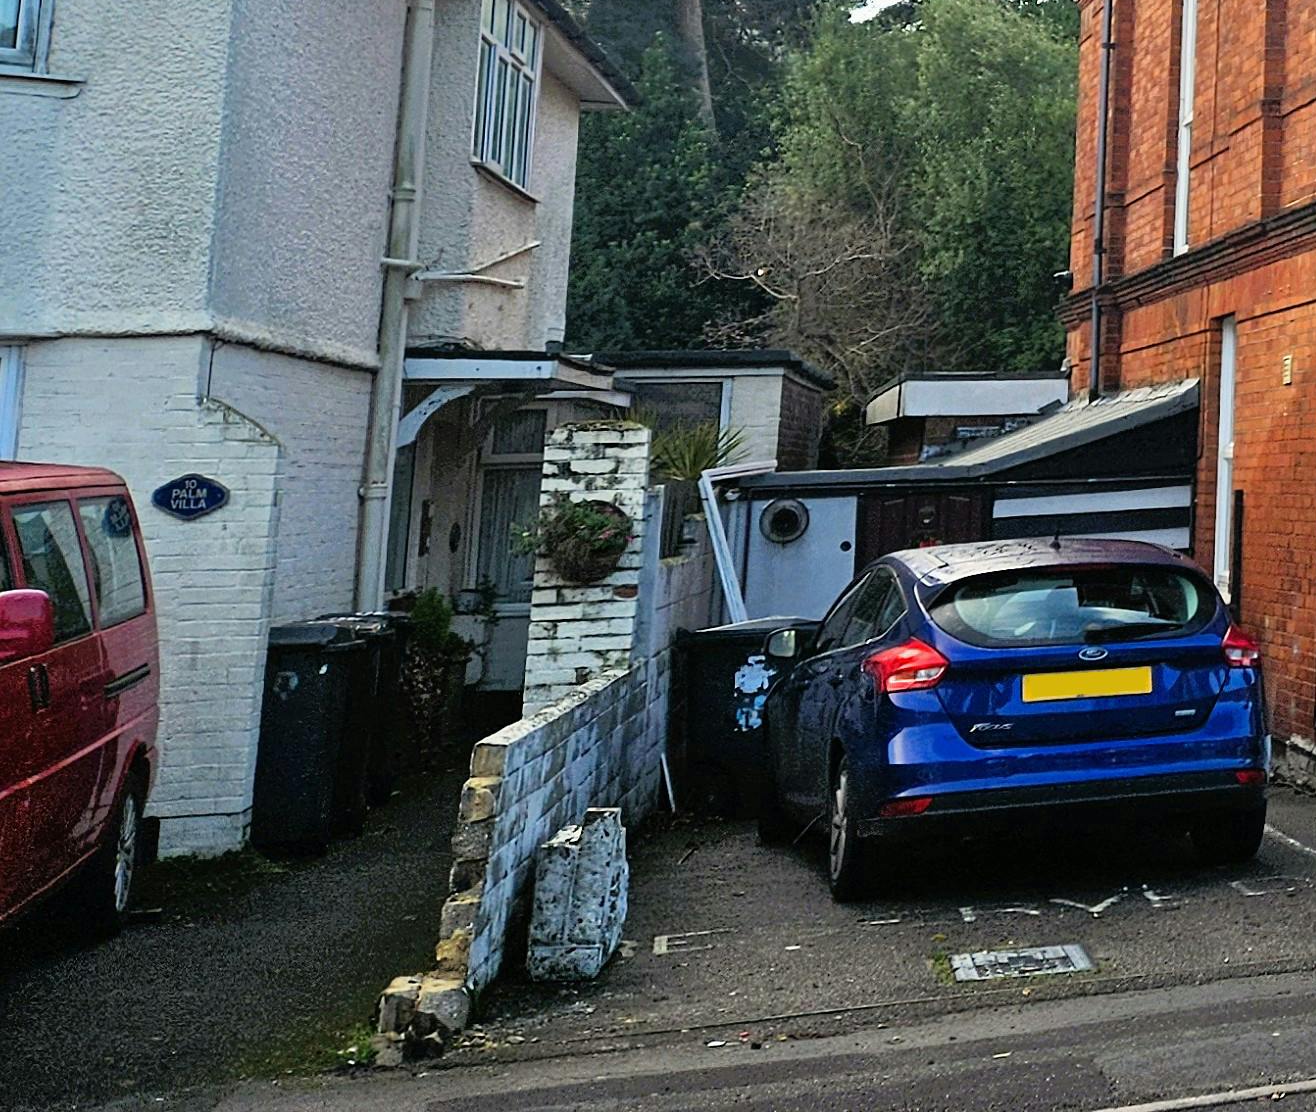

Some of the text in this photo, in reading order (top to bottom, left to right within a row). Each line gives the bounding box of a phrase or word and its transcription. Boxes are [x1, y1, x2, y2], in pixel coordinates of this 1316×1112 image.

[185, 479, 197, 489] 10
[171, 488, 208, 499] PALM
[170, 499, 207, 510] VILLA
